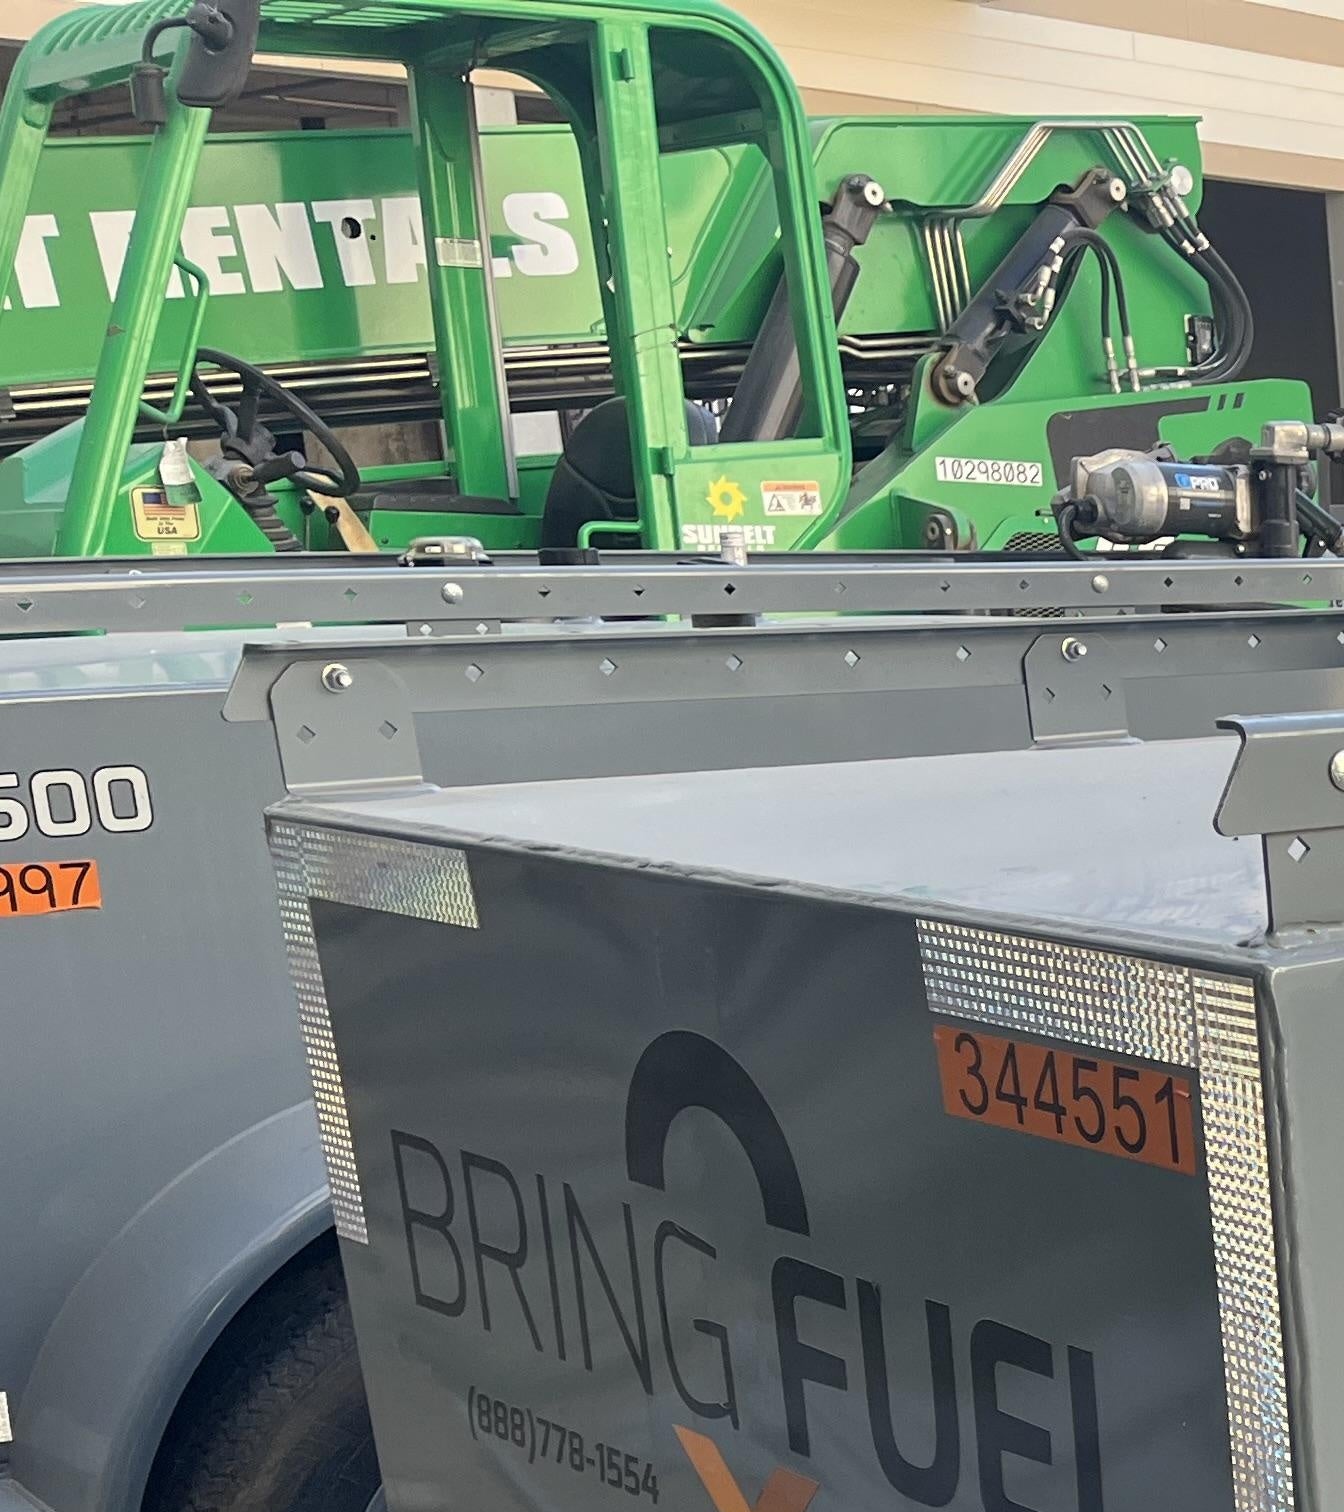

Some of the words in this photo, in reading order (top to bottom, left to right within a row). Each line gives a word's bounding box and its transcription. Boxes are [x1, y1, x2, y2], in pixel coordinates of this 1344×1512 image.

[157, 526, 177, 534] USA
[938, 459, 1041, 484] 10298082
[955, 1032, 1180, 1165] 344551
[391, 1128, 740, 1431] BRING
[467, 1385, 660, 1505] (888)778-1554
